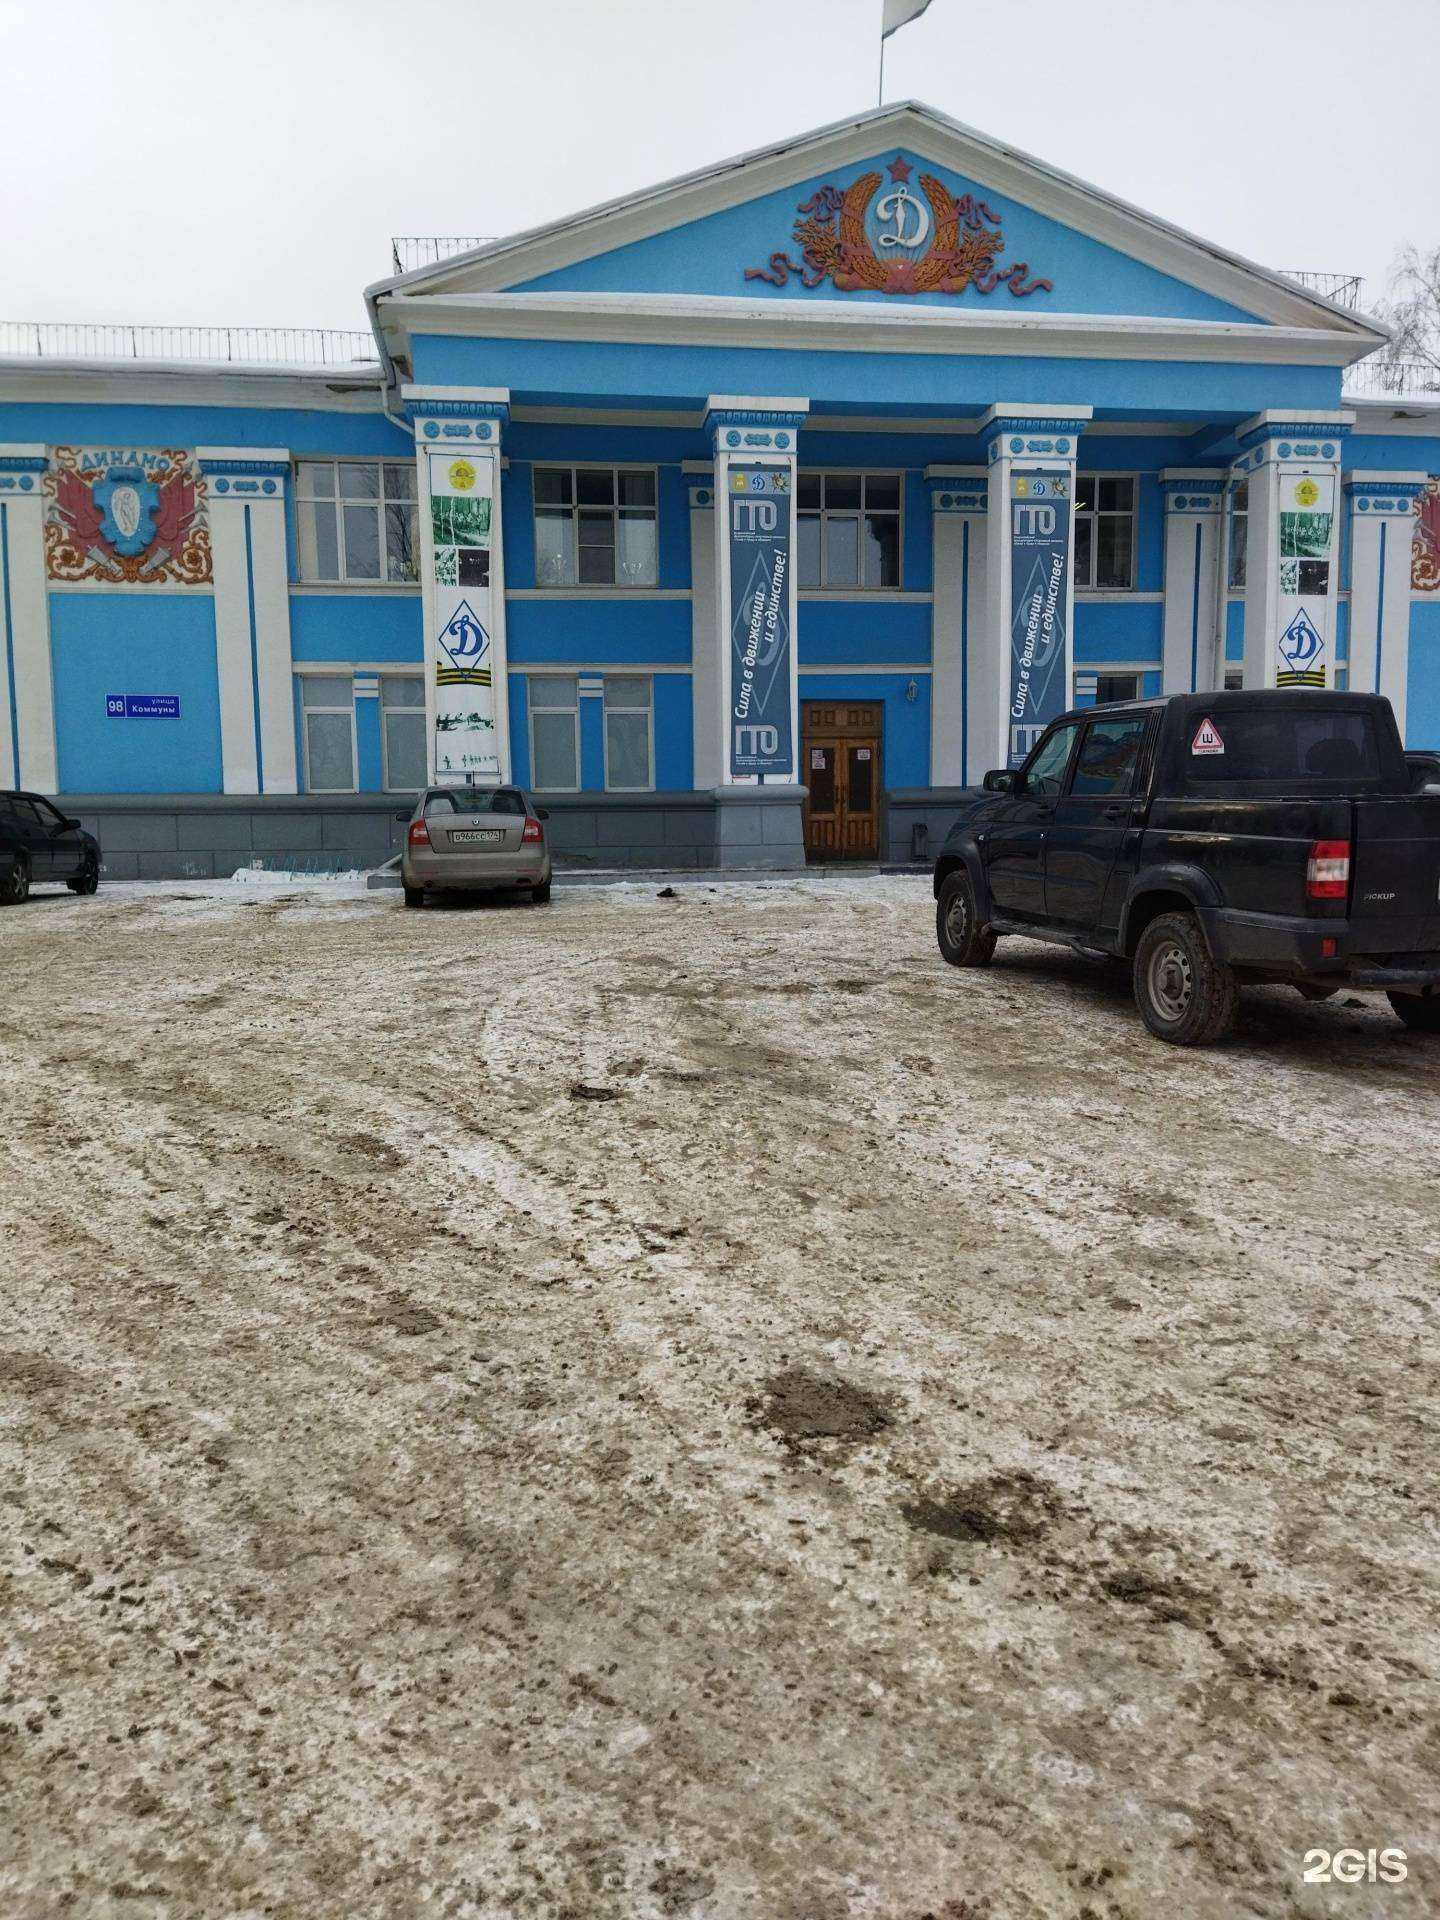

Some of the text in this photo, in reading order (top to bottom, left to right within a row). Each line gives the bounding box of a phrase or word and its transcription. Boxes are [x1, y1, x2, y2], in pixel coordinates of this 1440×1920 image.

[81, 451, 170, 472] ДИНАМО
[764, 549, 787, 643] и единстве!
[1041, 552, 1065, 644] и единстве!
[735, 591, 766, 719] Сила в движении
[1011, 593, 1042, 718] Сила в движении
[108, 700, 124, 712] 98
[132, 705, 175, 714] Коммуны
[1011, 724, 1048, 752] ГТ
